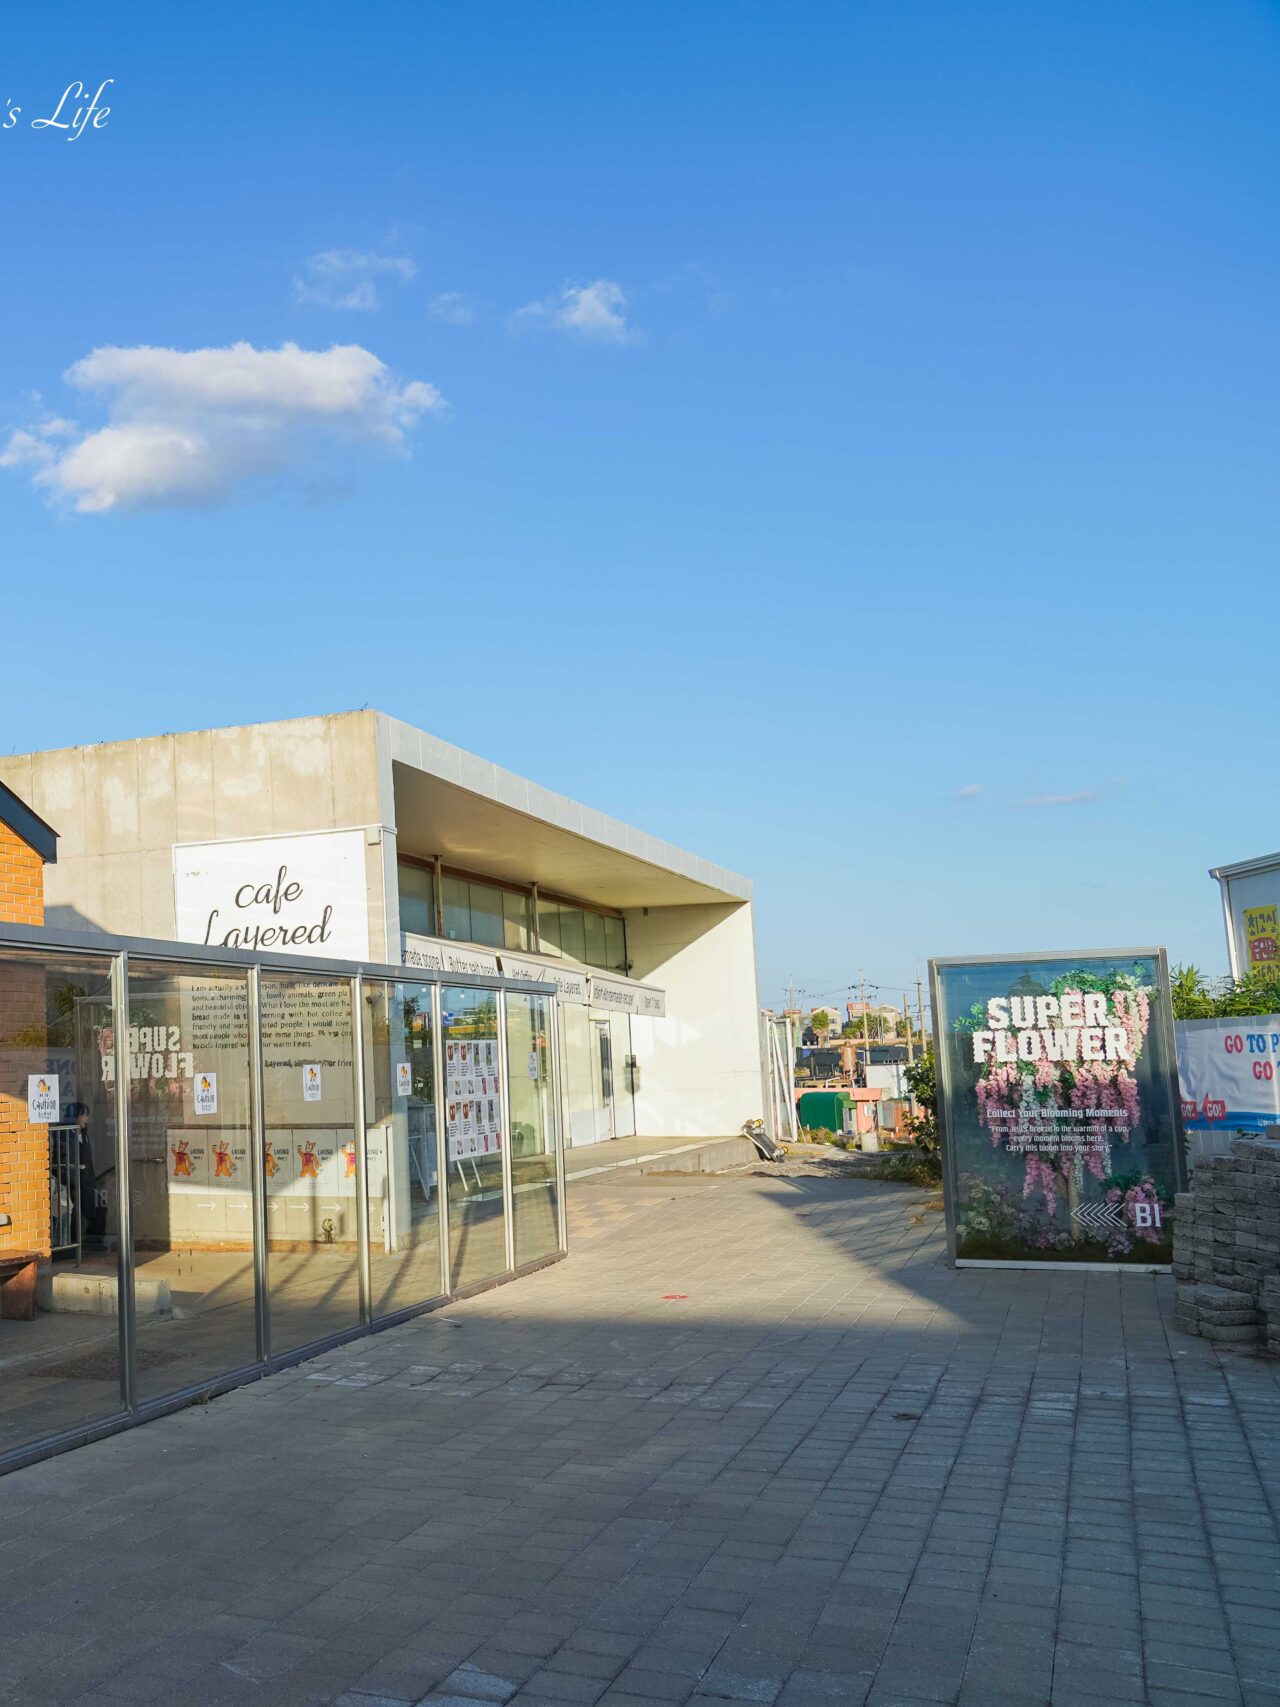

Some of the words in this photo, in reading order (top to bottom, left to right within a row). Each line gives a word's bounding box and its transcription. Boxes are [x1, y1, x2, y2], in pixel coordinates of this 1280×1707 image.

[235, 865, 303, 914] cafe
[988, 993, 1109, 1029] SUPER
[192, 1022, 216, 1031] friendly
[973, 1027, 1131, 1062] FLOWER
[1224, 1034, 1244, 1054] GO
[1246, 1034, 1266, 1053] TO
[1253, 1061, 1273, 1081] GO
[987, 1109, 1015, 1117] Collect
[1018, 1109, 1038, 1117] Your
[1041, 1108, 1083, 1118] Blooming
[1086, 1108, 1129, 1117] Moments
[1206, 1103, 1222, 1117] GO!
[1006, 1145, 1024, 1153] Carry
